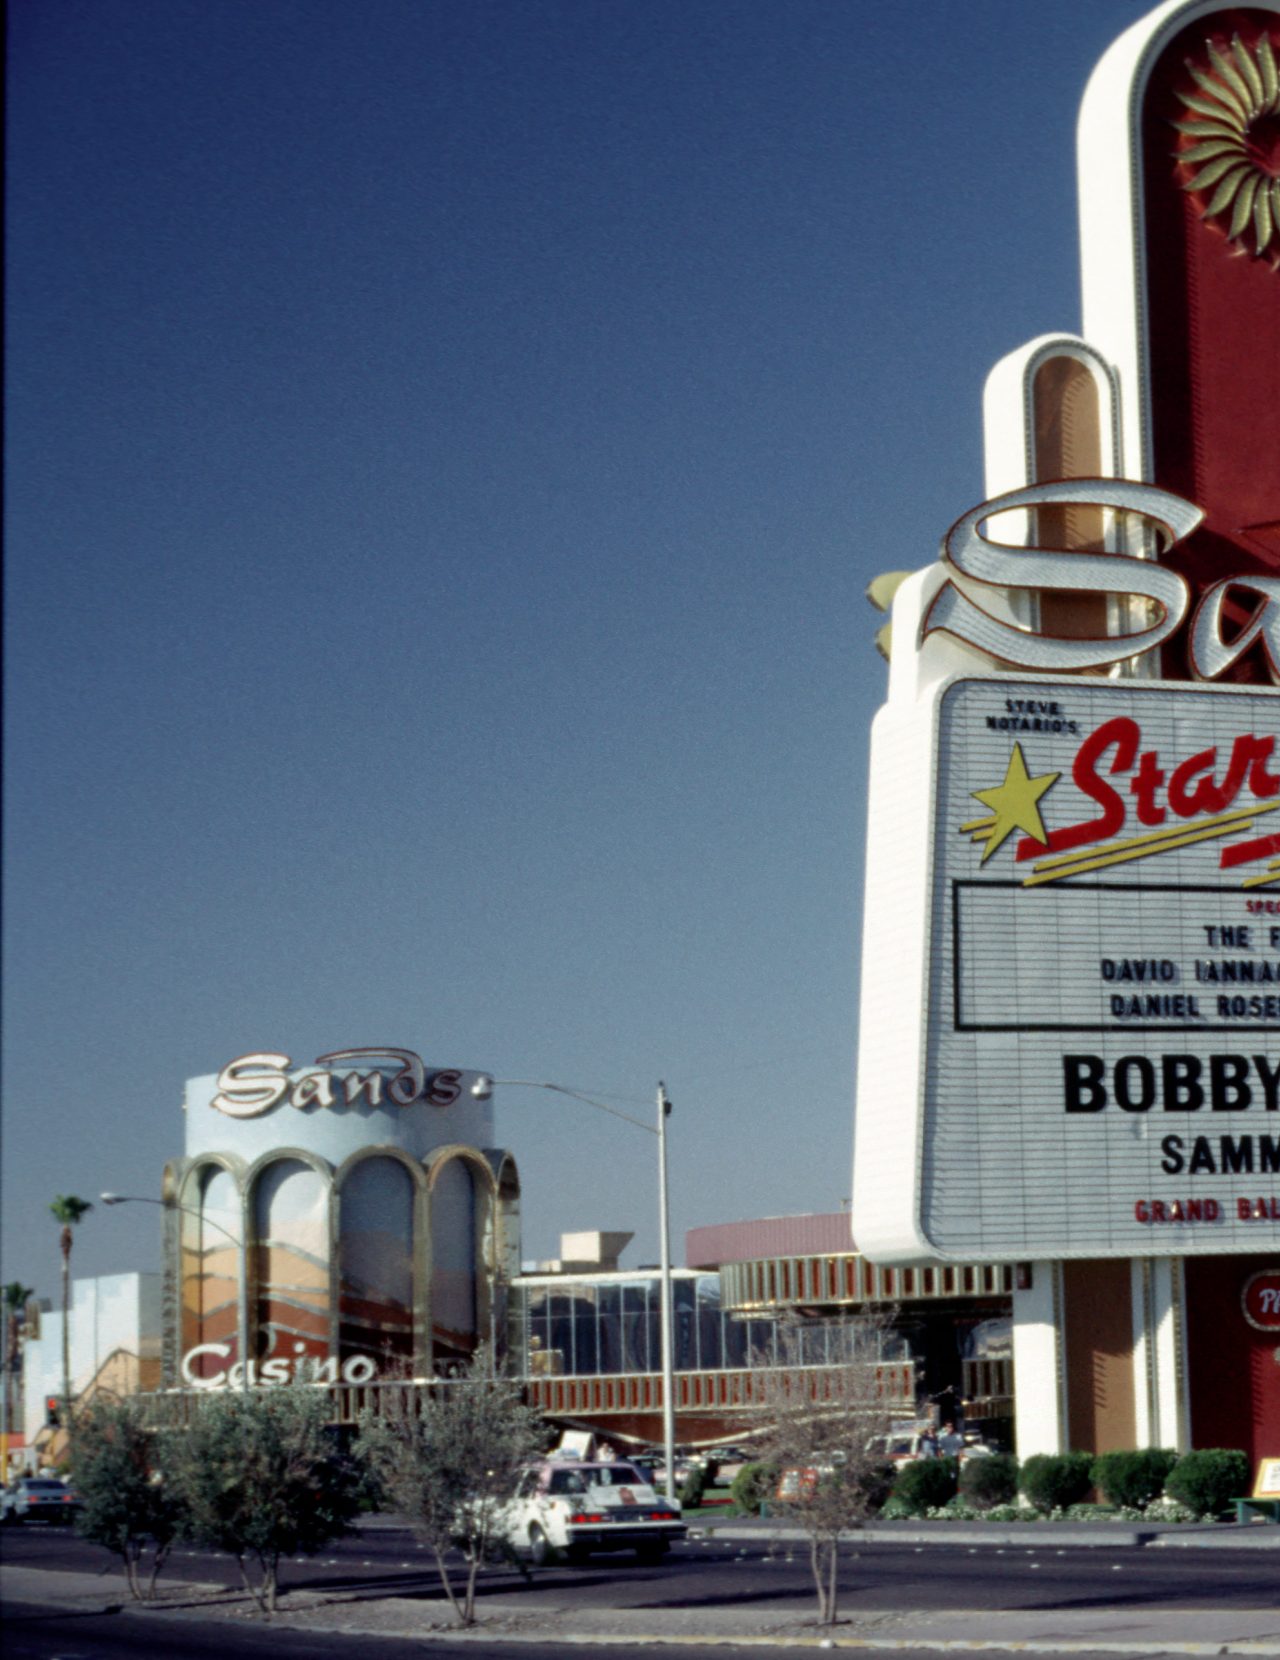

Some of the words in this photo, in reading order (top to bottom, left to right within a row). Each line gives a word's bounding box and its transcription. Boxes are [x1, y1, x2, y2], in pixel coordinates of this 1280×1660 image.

[1005, 699, 1060, 715] STEVE
[985, 716, 1077, 733] NOTARIO'S
[1203, 925, 1249, 948] THE
[1101, 958, 1175, 981] DAVID
[1110, 994, 1199, 1018] DANIEL
[209, 1047, 463, 1118] Sands
[1135, 1198, 1219, 1223] GRAND
[181, 1343, 375, 1387] Casino
